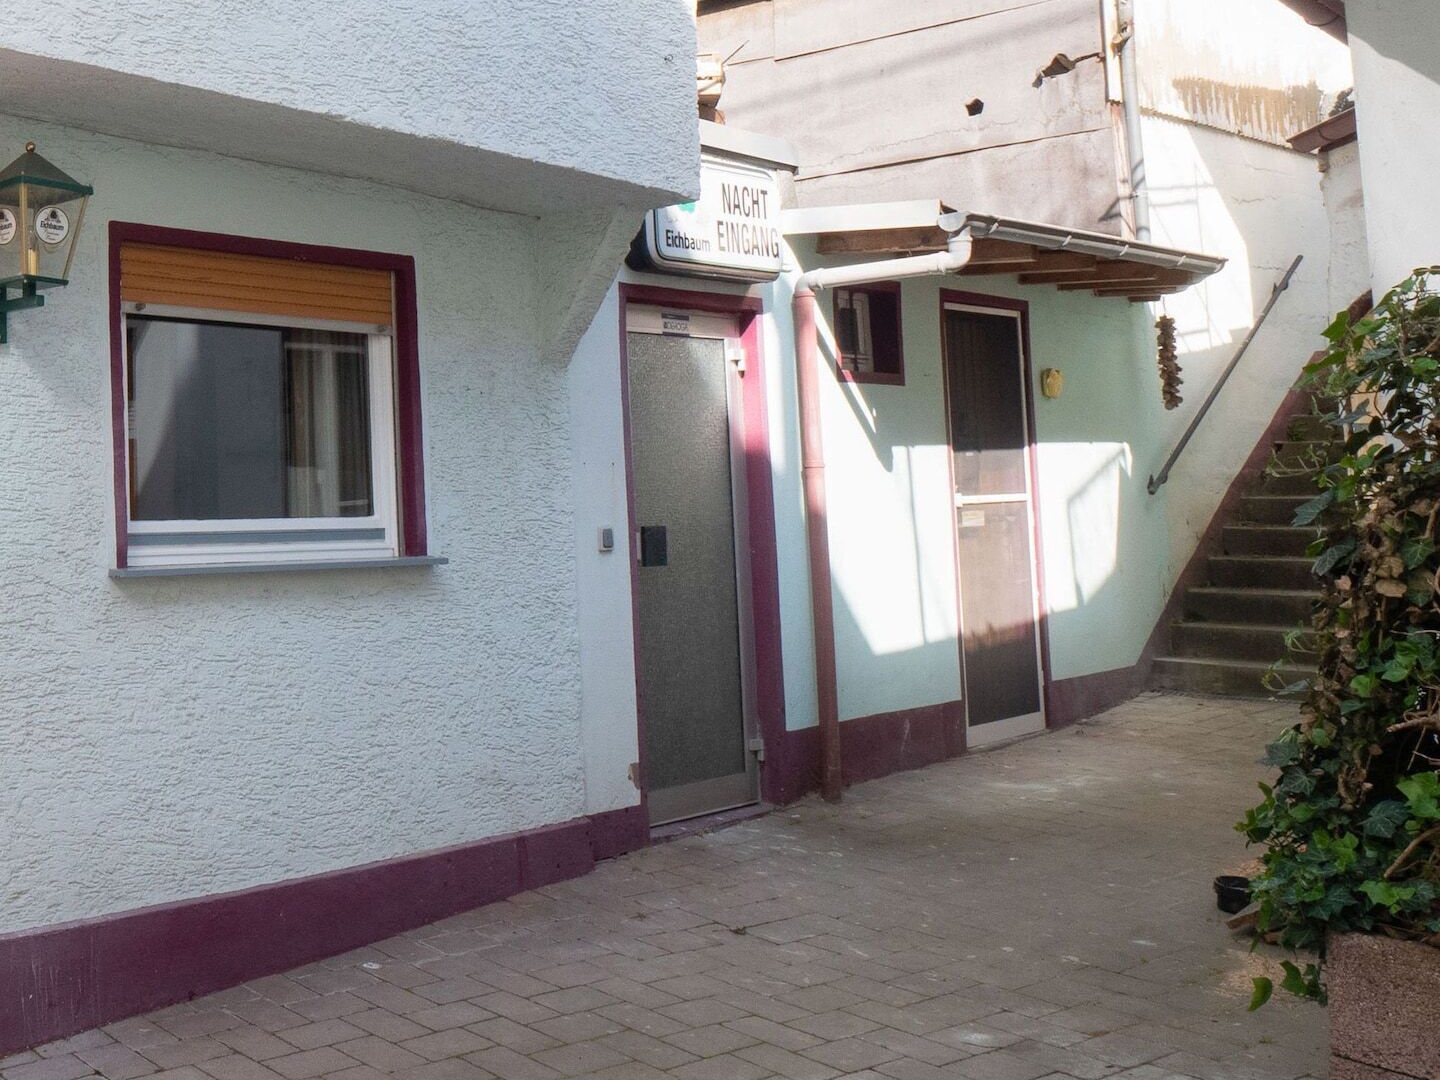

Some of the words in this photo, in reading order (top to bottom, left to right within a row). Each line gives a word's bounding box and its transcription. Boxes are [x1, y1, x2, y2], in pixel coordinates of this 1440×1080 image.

[722, 183, 768, 219] NACHT
[665, 229, 710, 251] Eichbaum
[717, 220, 779, 258] EINGANG
